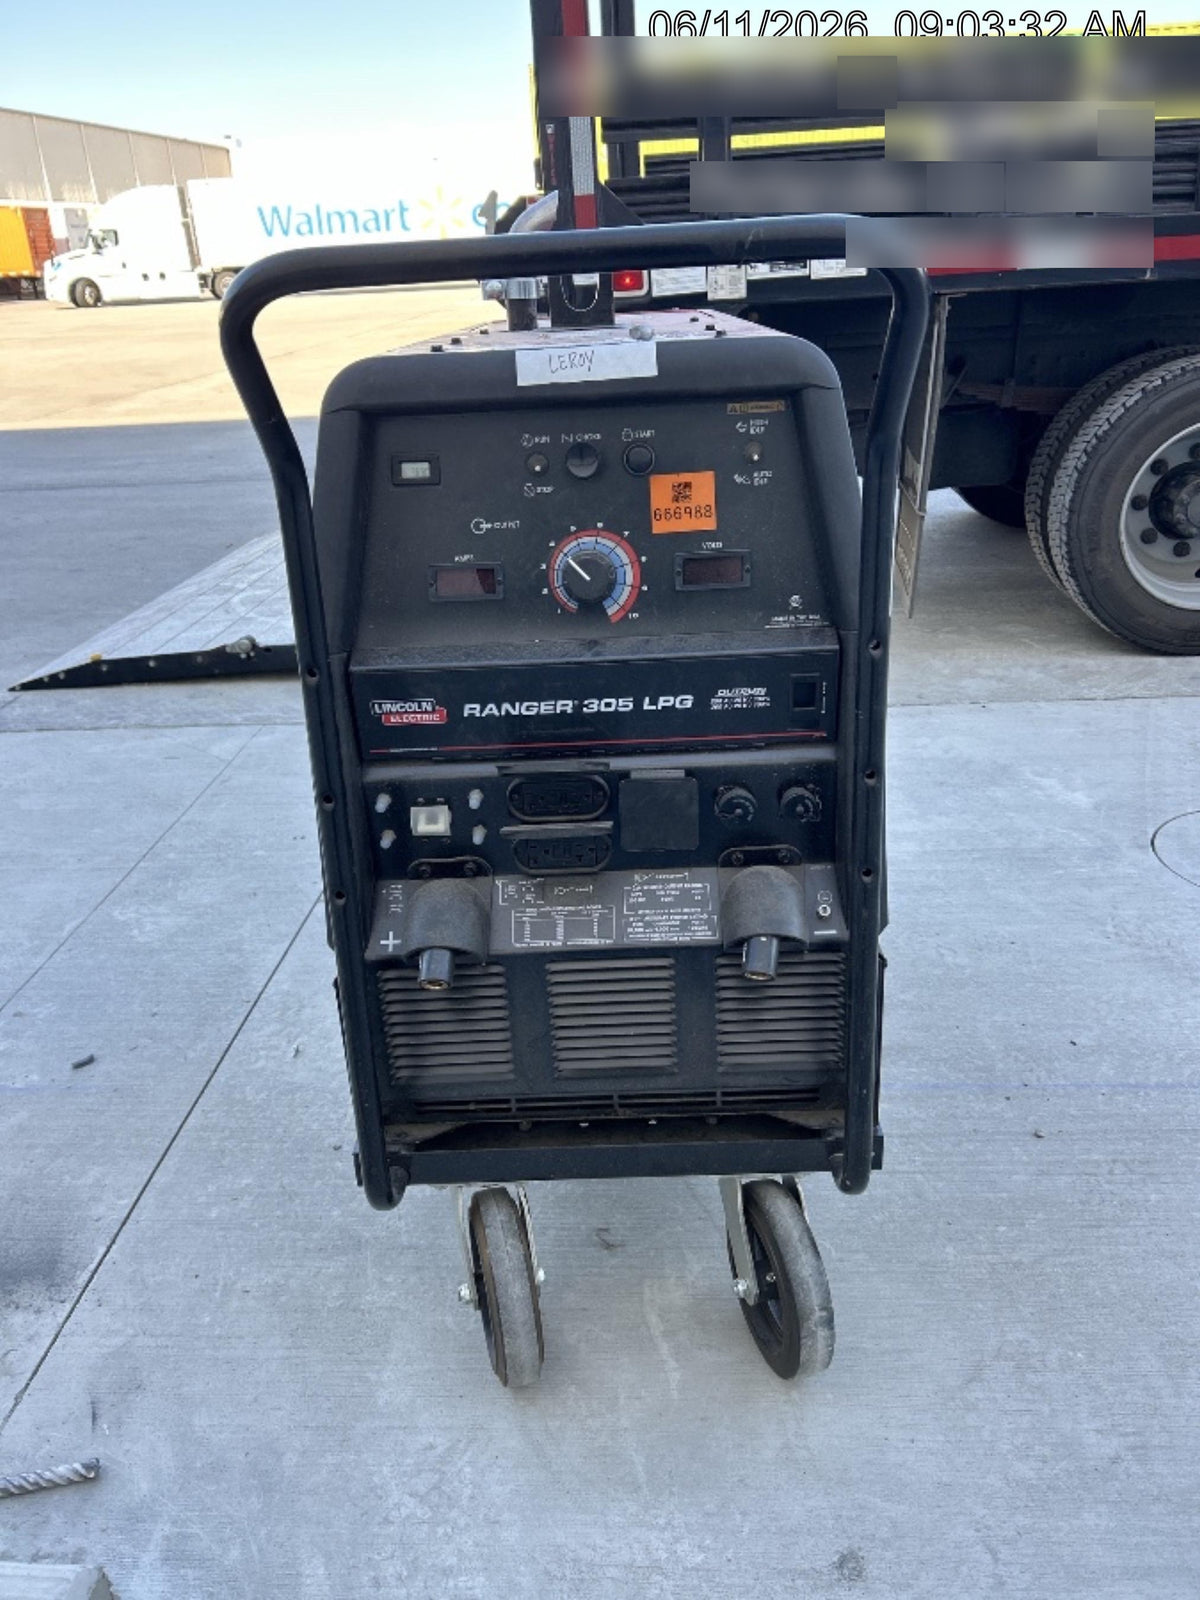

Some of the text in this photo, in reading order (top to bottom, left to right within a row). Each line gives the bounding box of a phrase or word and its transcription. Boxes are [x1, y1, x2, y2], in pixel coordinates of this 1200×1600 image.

[257, 199, 410, 238] Walmart
[549, 350, 594, 374] LEROY
[374, 702, 433, 713] LINCOLN
[463, 700, 574, 717] RANGER
[582, 697, 634, 713] 305
[643, 694, 694, 711] LPG
[390, 714, 440, 723] ELECTRIC
